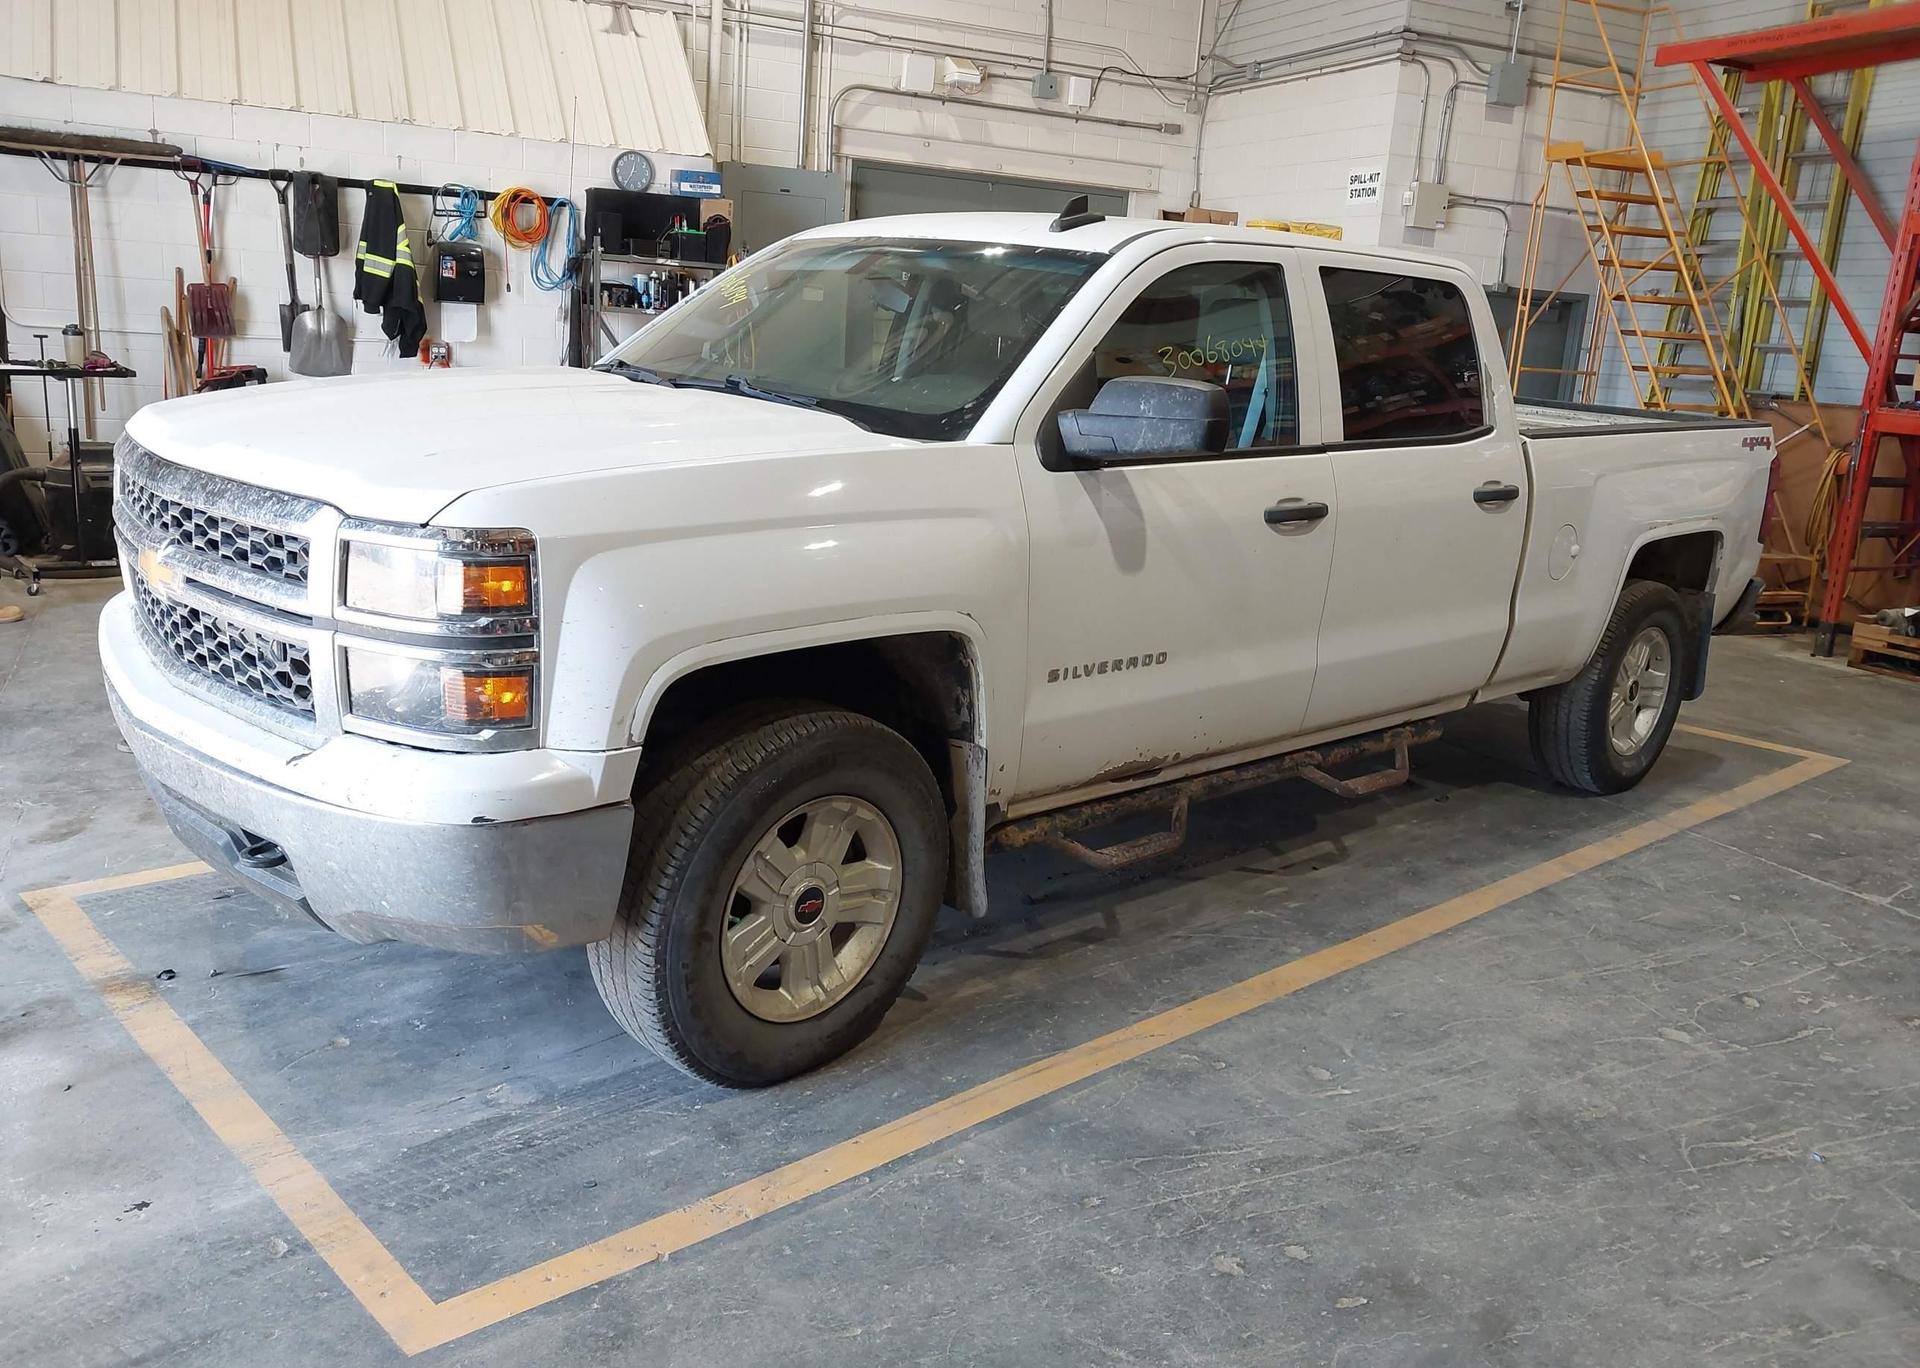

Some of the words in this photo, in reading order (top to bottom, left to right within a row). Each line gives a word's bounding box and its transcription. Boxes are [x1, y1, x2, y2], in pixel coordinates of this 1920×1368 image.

[1349, 172, 1381, 185] SPILL-KIT
[1349, 186, 1377, 199] STATION
[1047, 651, 1168, 683] SILVERADO
